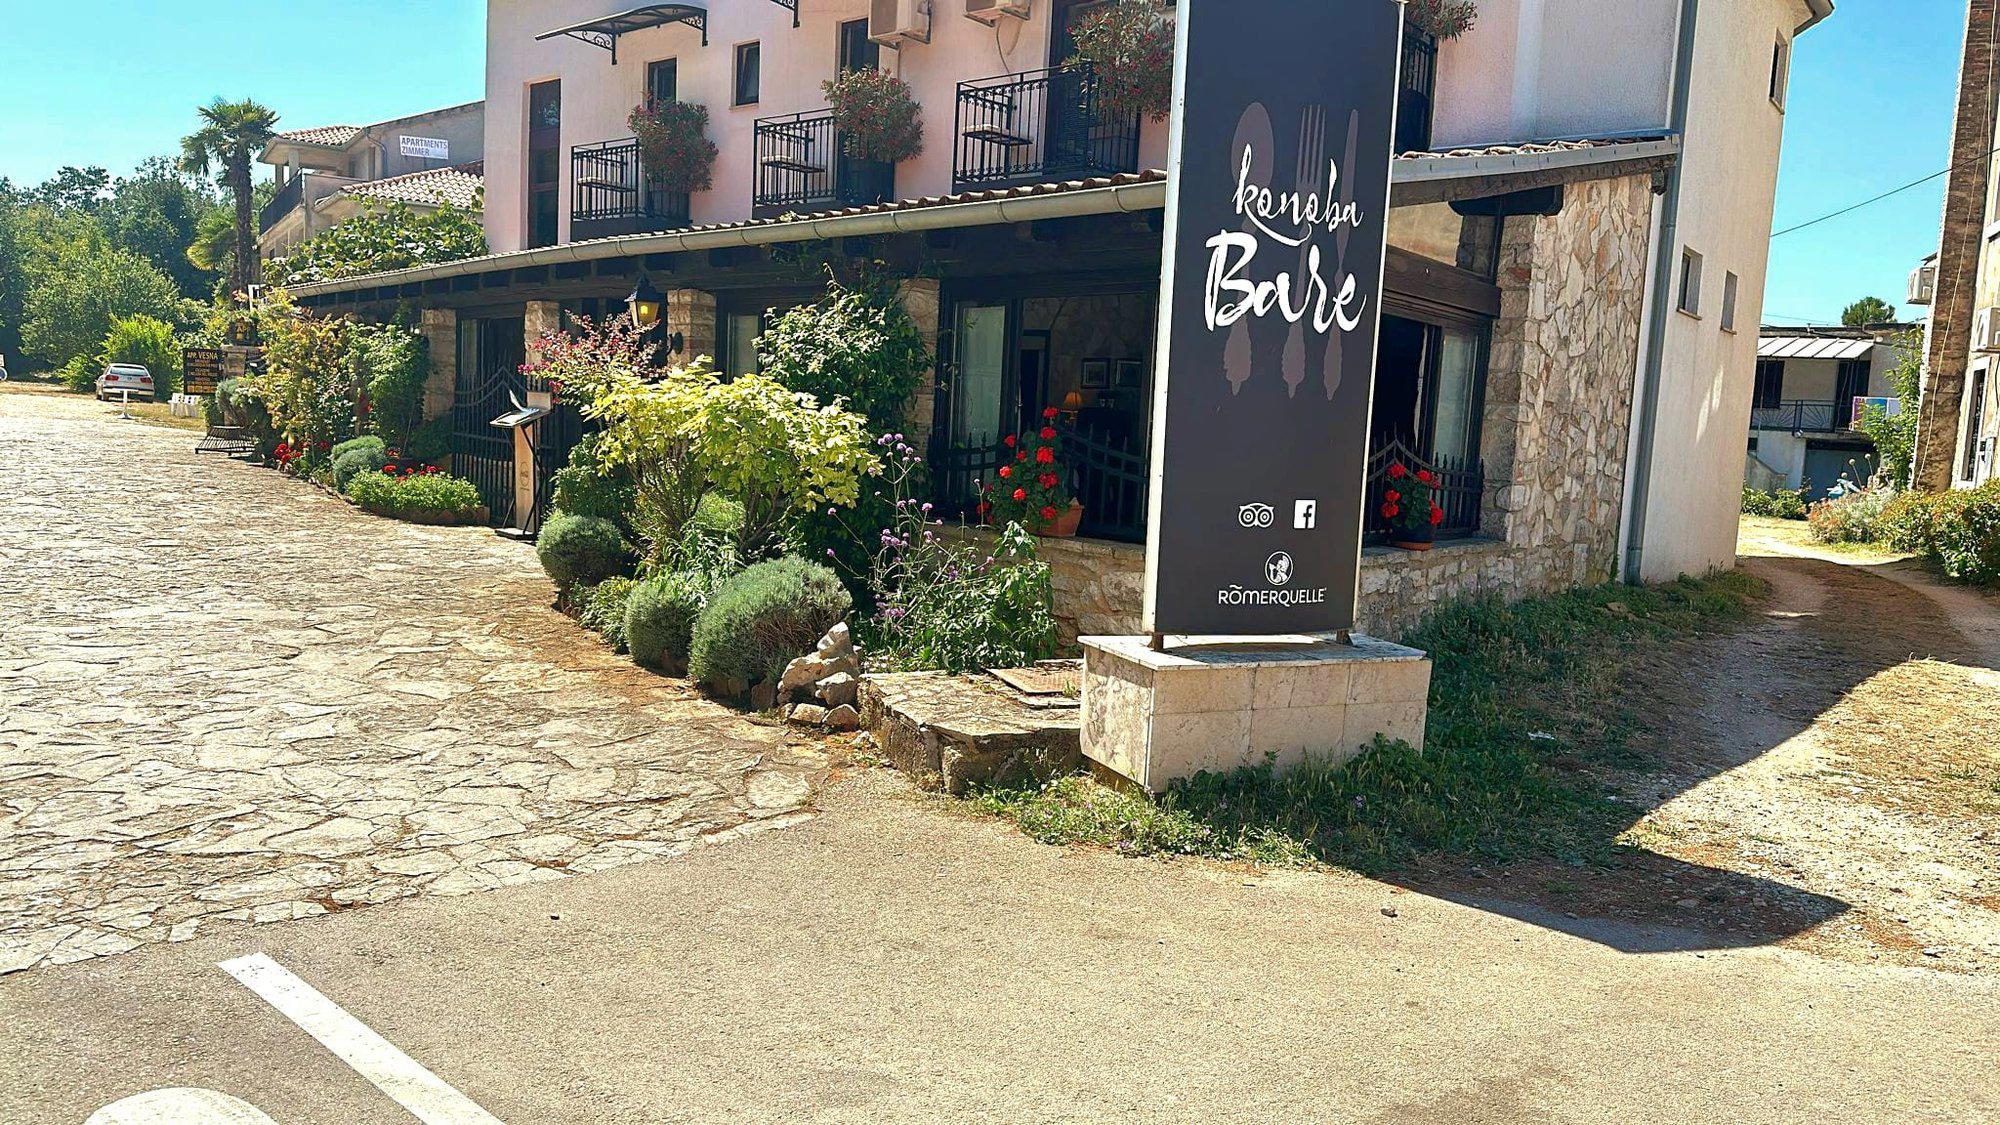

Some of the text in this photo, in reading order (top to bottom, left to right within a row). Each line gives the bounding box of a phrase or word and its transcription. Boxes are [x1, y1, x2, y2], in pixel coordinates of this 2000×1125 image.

[401, 137, 448, 150] APARTMENTS
[401, 146, 430, 156] ZIMMER
[1231, 143, 1364, 247] konoba
[1204, 229, 1368, 334] Bare
[199, 351, 218, 360] VESNA
